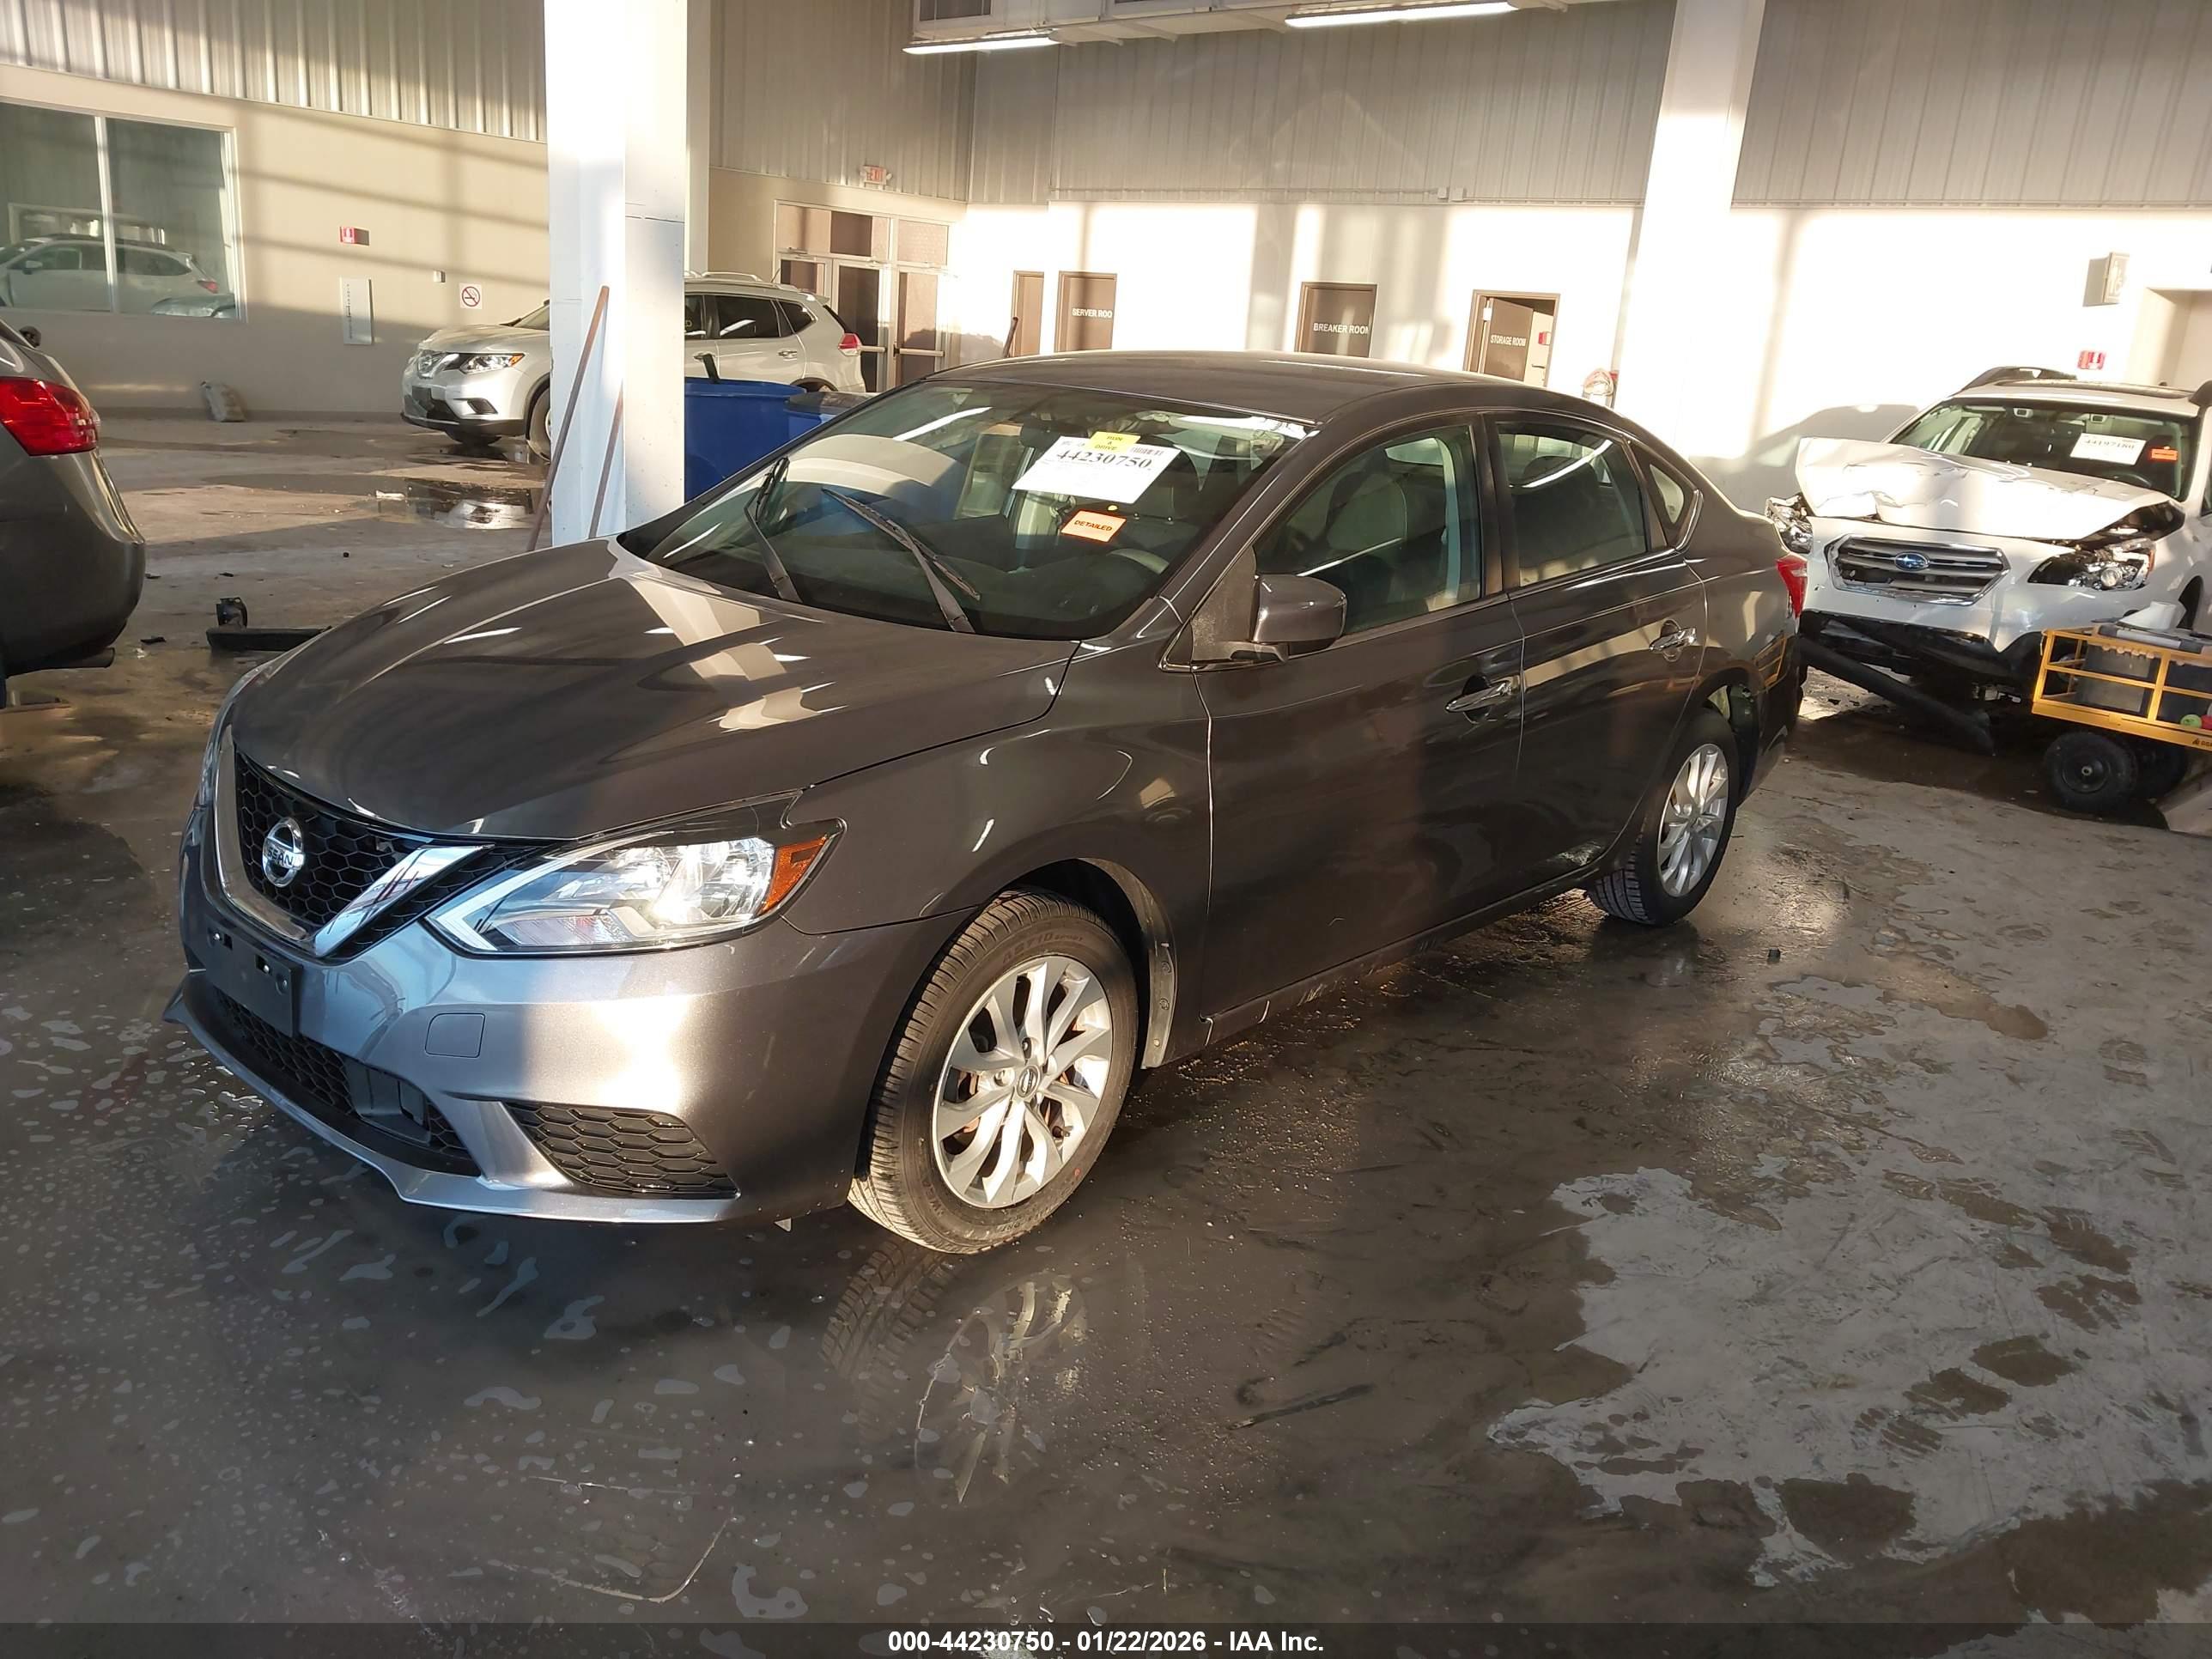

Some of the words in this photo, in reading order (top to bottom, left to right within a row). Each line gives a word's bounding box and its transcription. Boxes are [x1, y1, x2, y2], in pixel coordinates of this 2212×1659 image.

[1072, 307, 1097, 317] SERVER
[1097, 309, 1113, 319] ROO
[1313, 322, 1347, 333] BREAKER
[1490, 334, 1512, 346] STORAGE
[1512, 337, 1527, 347] ROOM
[1073, 520, 1113, 532] DETAILED
